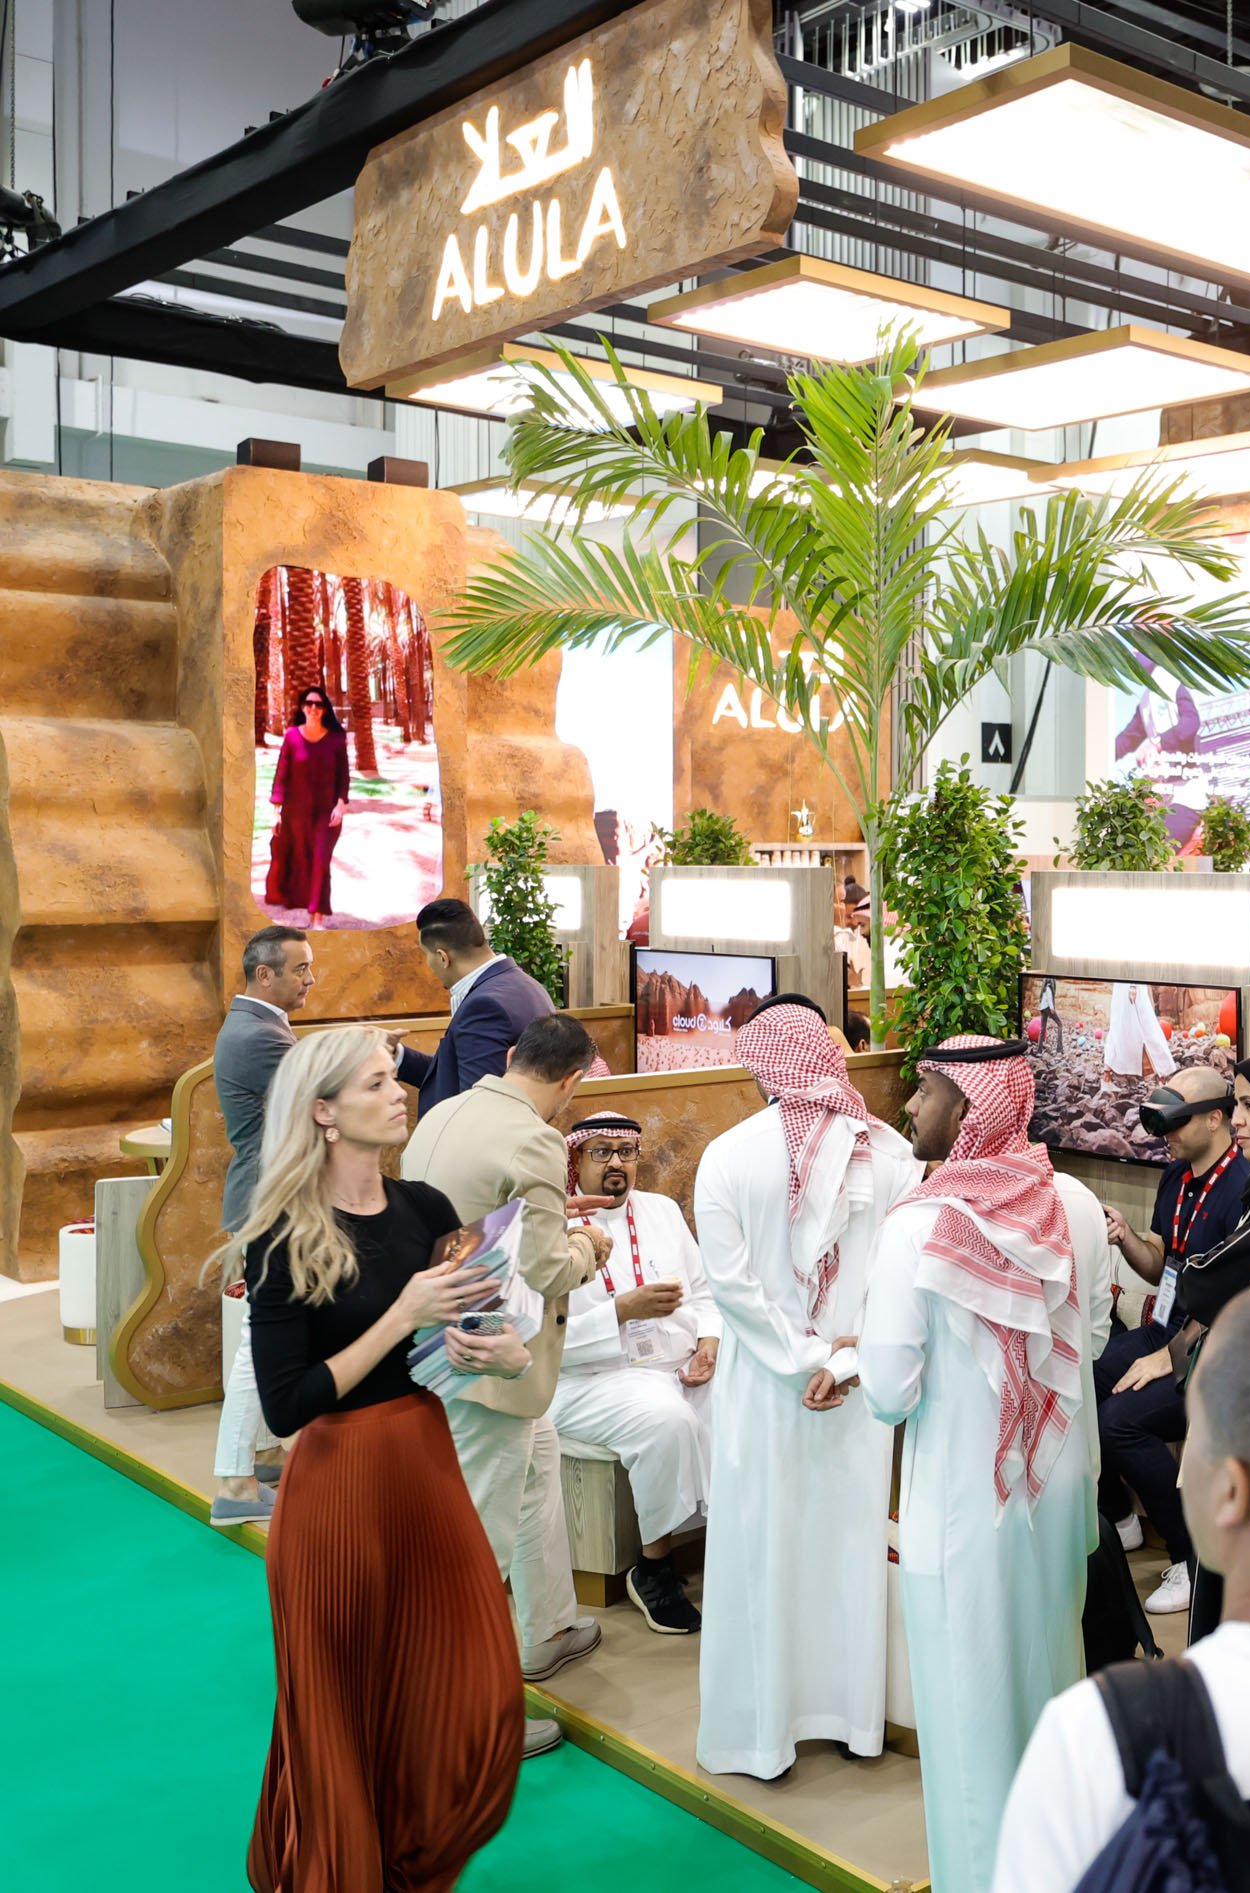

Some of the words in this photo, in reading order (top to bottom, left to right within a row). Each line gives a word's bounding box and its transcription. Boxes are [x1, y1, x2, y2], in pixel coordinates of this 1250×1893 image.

[460, 57, 594, 215] العلا
[431, 166, 627, 322] ALULA
[672, 1014, 697, 1029] cloud
